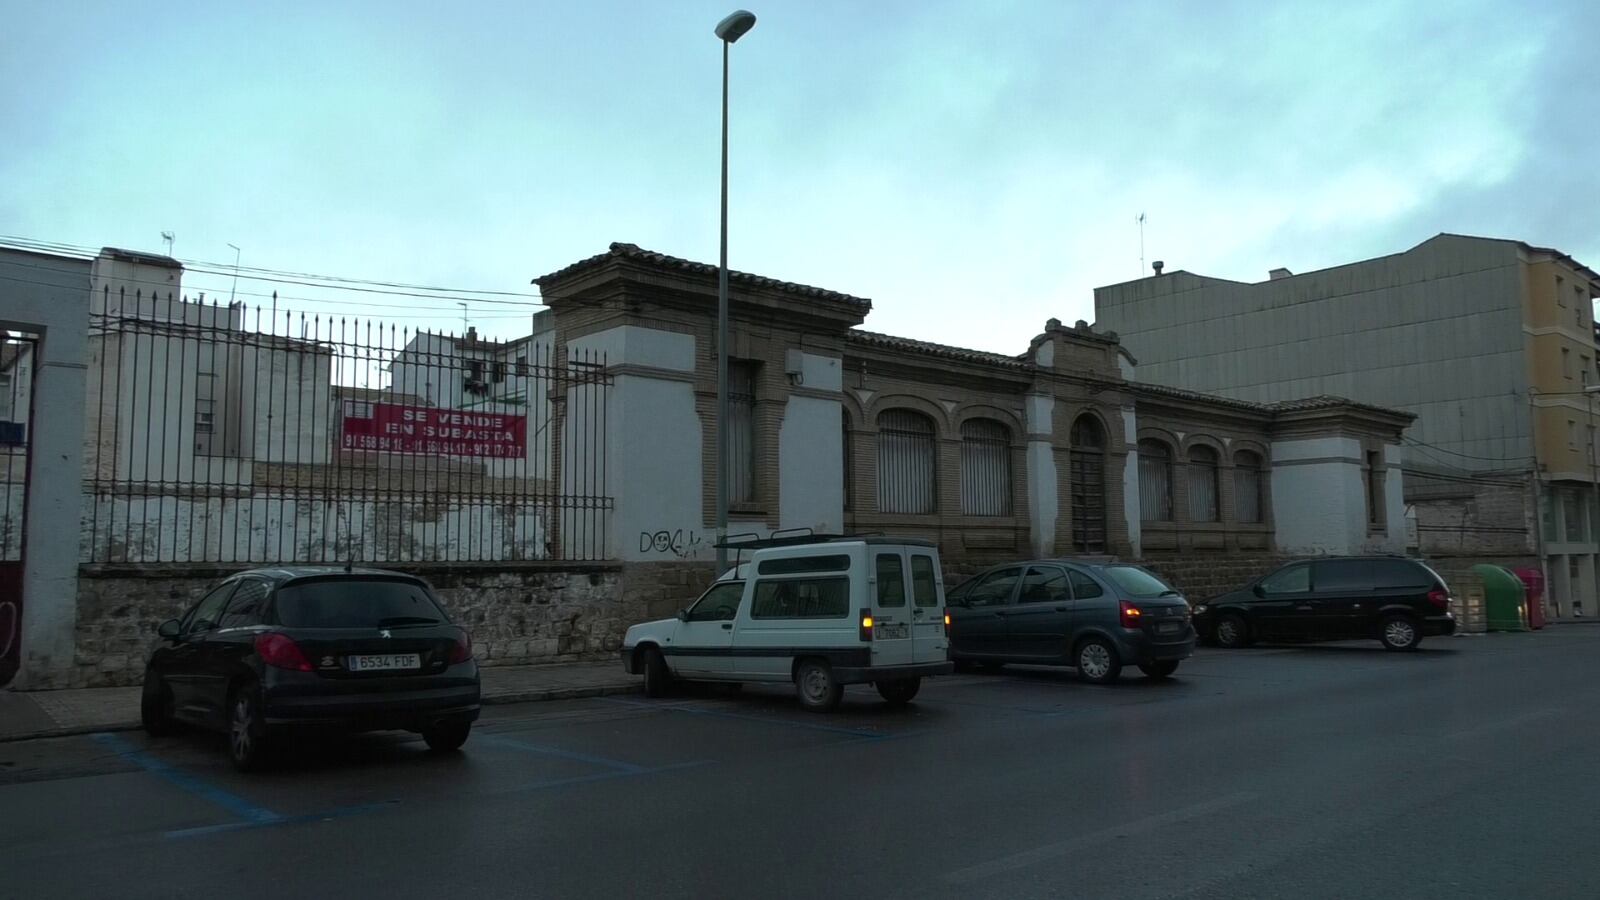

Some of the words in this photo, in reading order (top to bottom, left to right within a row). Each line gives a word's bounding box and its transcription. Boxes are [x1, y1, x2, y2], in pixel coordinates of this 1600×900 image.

[404, 410, 427, 422] SE
[438, 413, 502, 428] VENDE
[386, 422, 414, 435] EN
[424, 426, 513, 441] SUBASTA
[345, 434, 357, 447] 91
[360, 656, 391, 668] 6534
[394, 655, 416, 667] FDF
